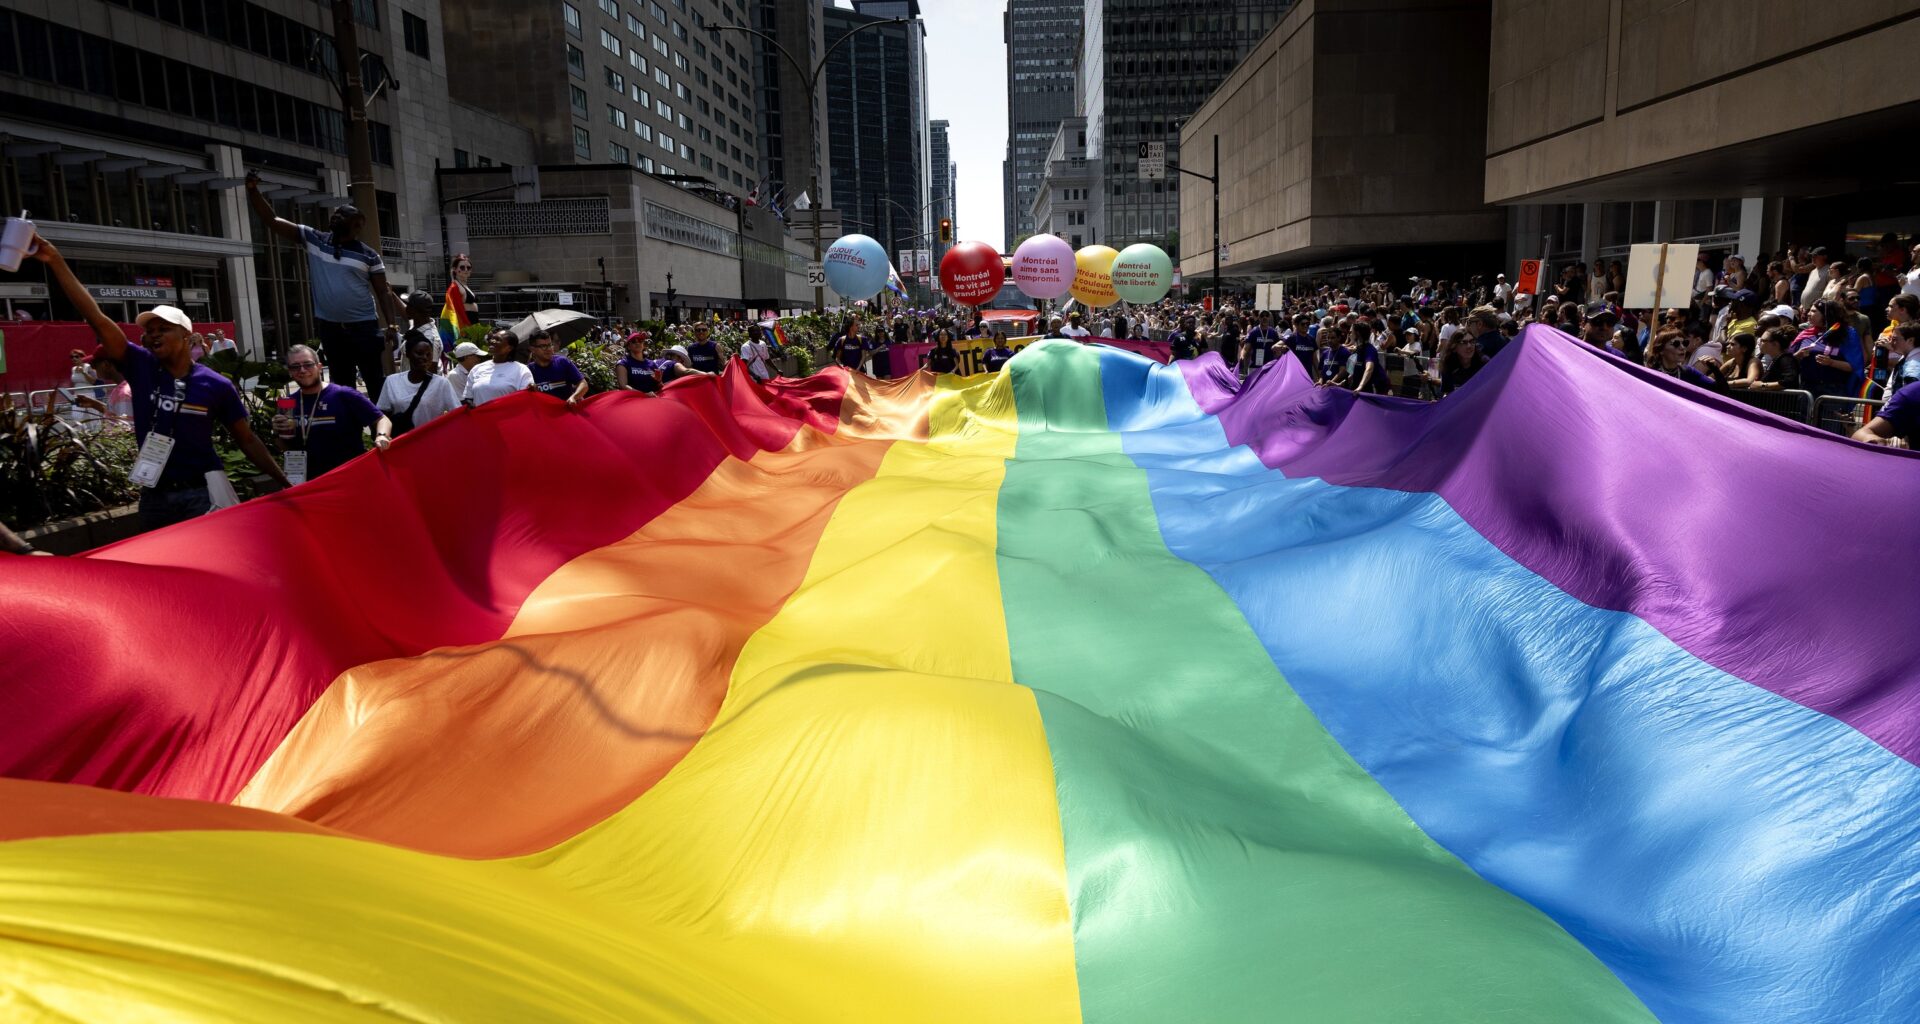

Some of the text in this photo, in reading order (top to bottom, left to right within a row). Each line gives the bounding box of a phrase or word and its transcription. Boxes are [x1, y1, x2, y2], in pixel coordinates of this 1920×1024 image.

[1022, 256, 1058, 265] Montréal
[1020, 265, 1038, 273] aime
[1118, 262, 1151, 270] Montréal
[809, 272, 825, 283] 50
[953, 269, 990, 281] Montréal
[1017, 274, 1062, 283] compromis.
[1098, 273, 1111, 281] vib
[966, 281, 979, 289] vit
[980, 280, 990, 288] au
[99, 288, 158, 298] GARE CENTRALE
[953, 290, 976, 298] grand
